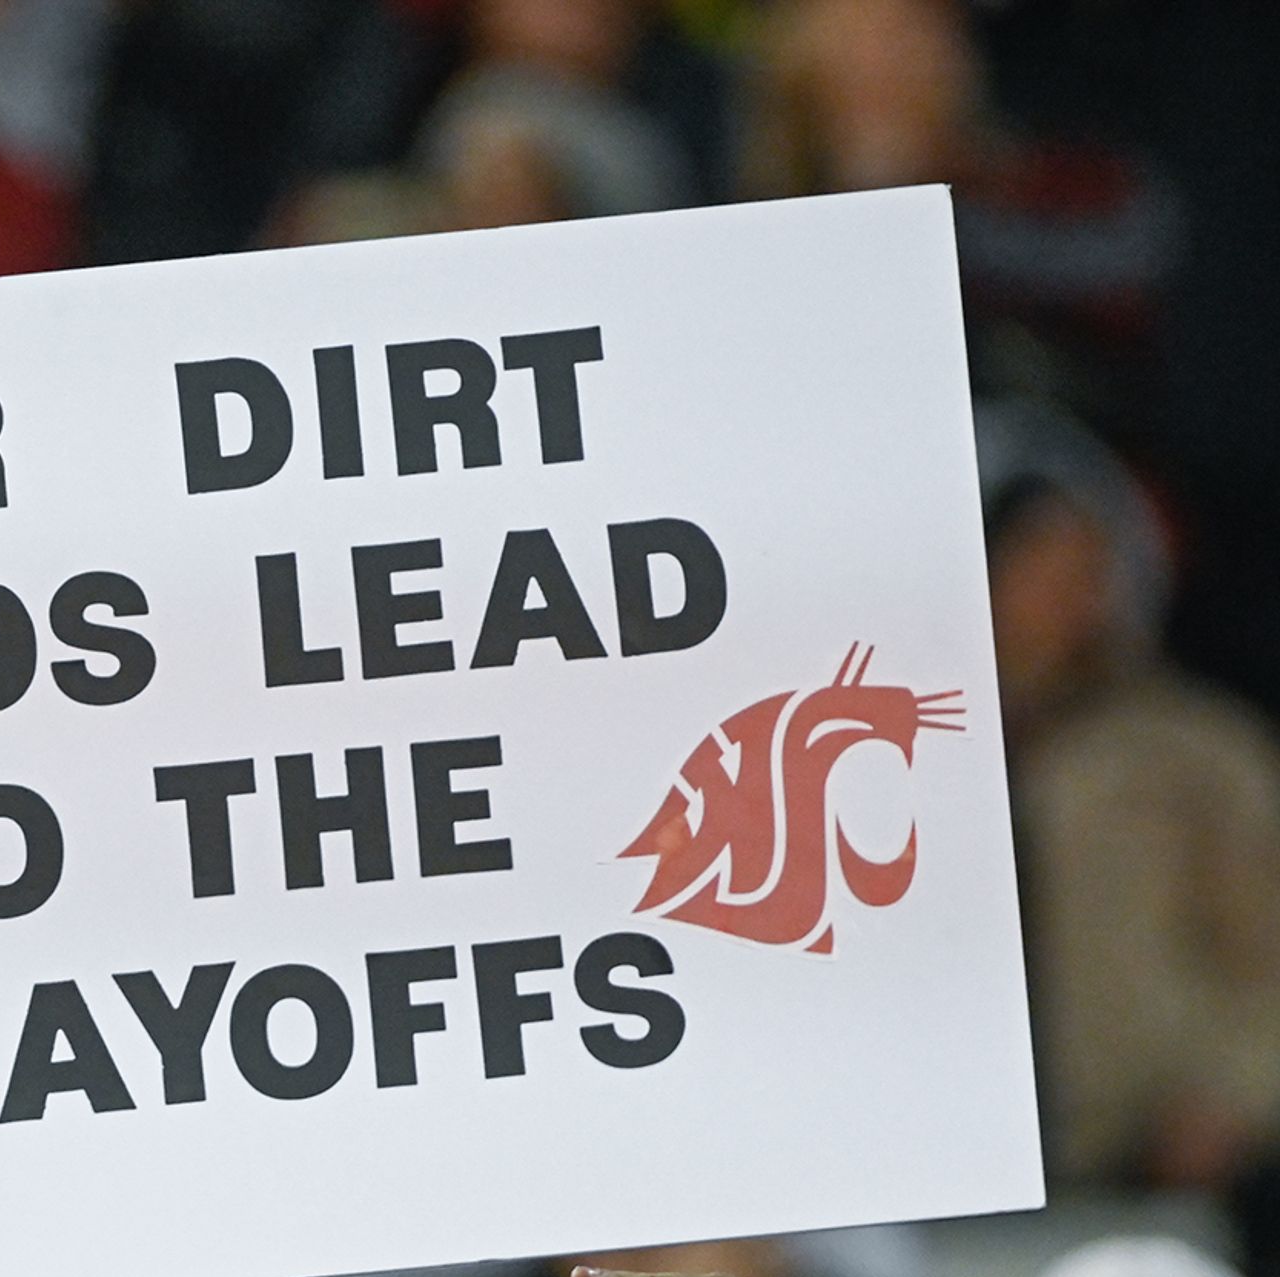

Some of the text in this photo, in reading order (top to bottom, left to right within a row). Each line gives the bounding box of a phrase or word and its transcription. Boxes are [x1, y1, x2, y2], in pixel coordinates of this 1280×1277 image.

[175, 326, 603, 494] DIRT
[256, 518, 726, 688] LEAD
[153, 736, 513, 898] THE
